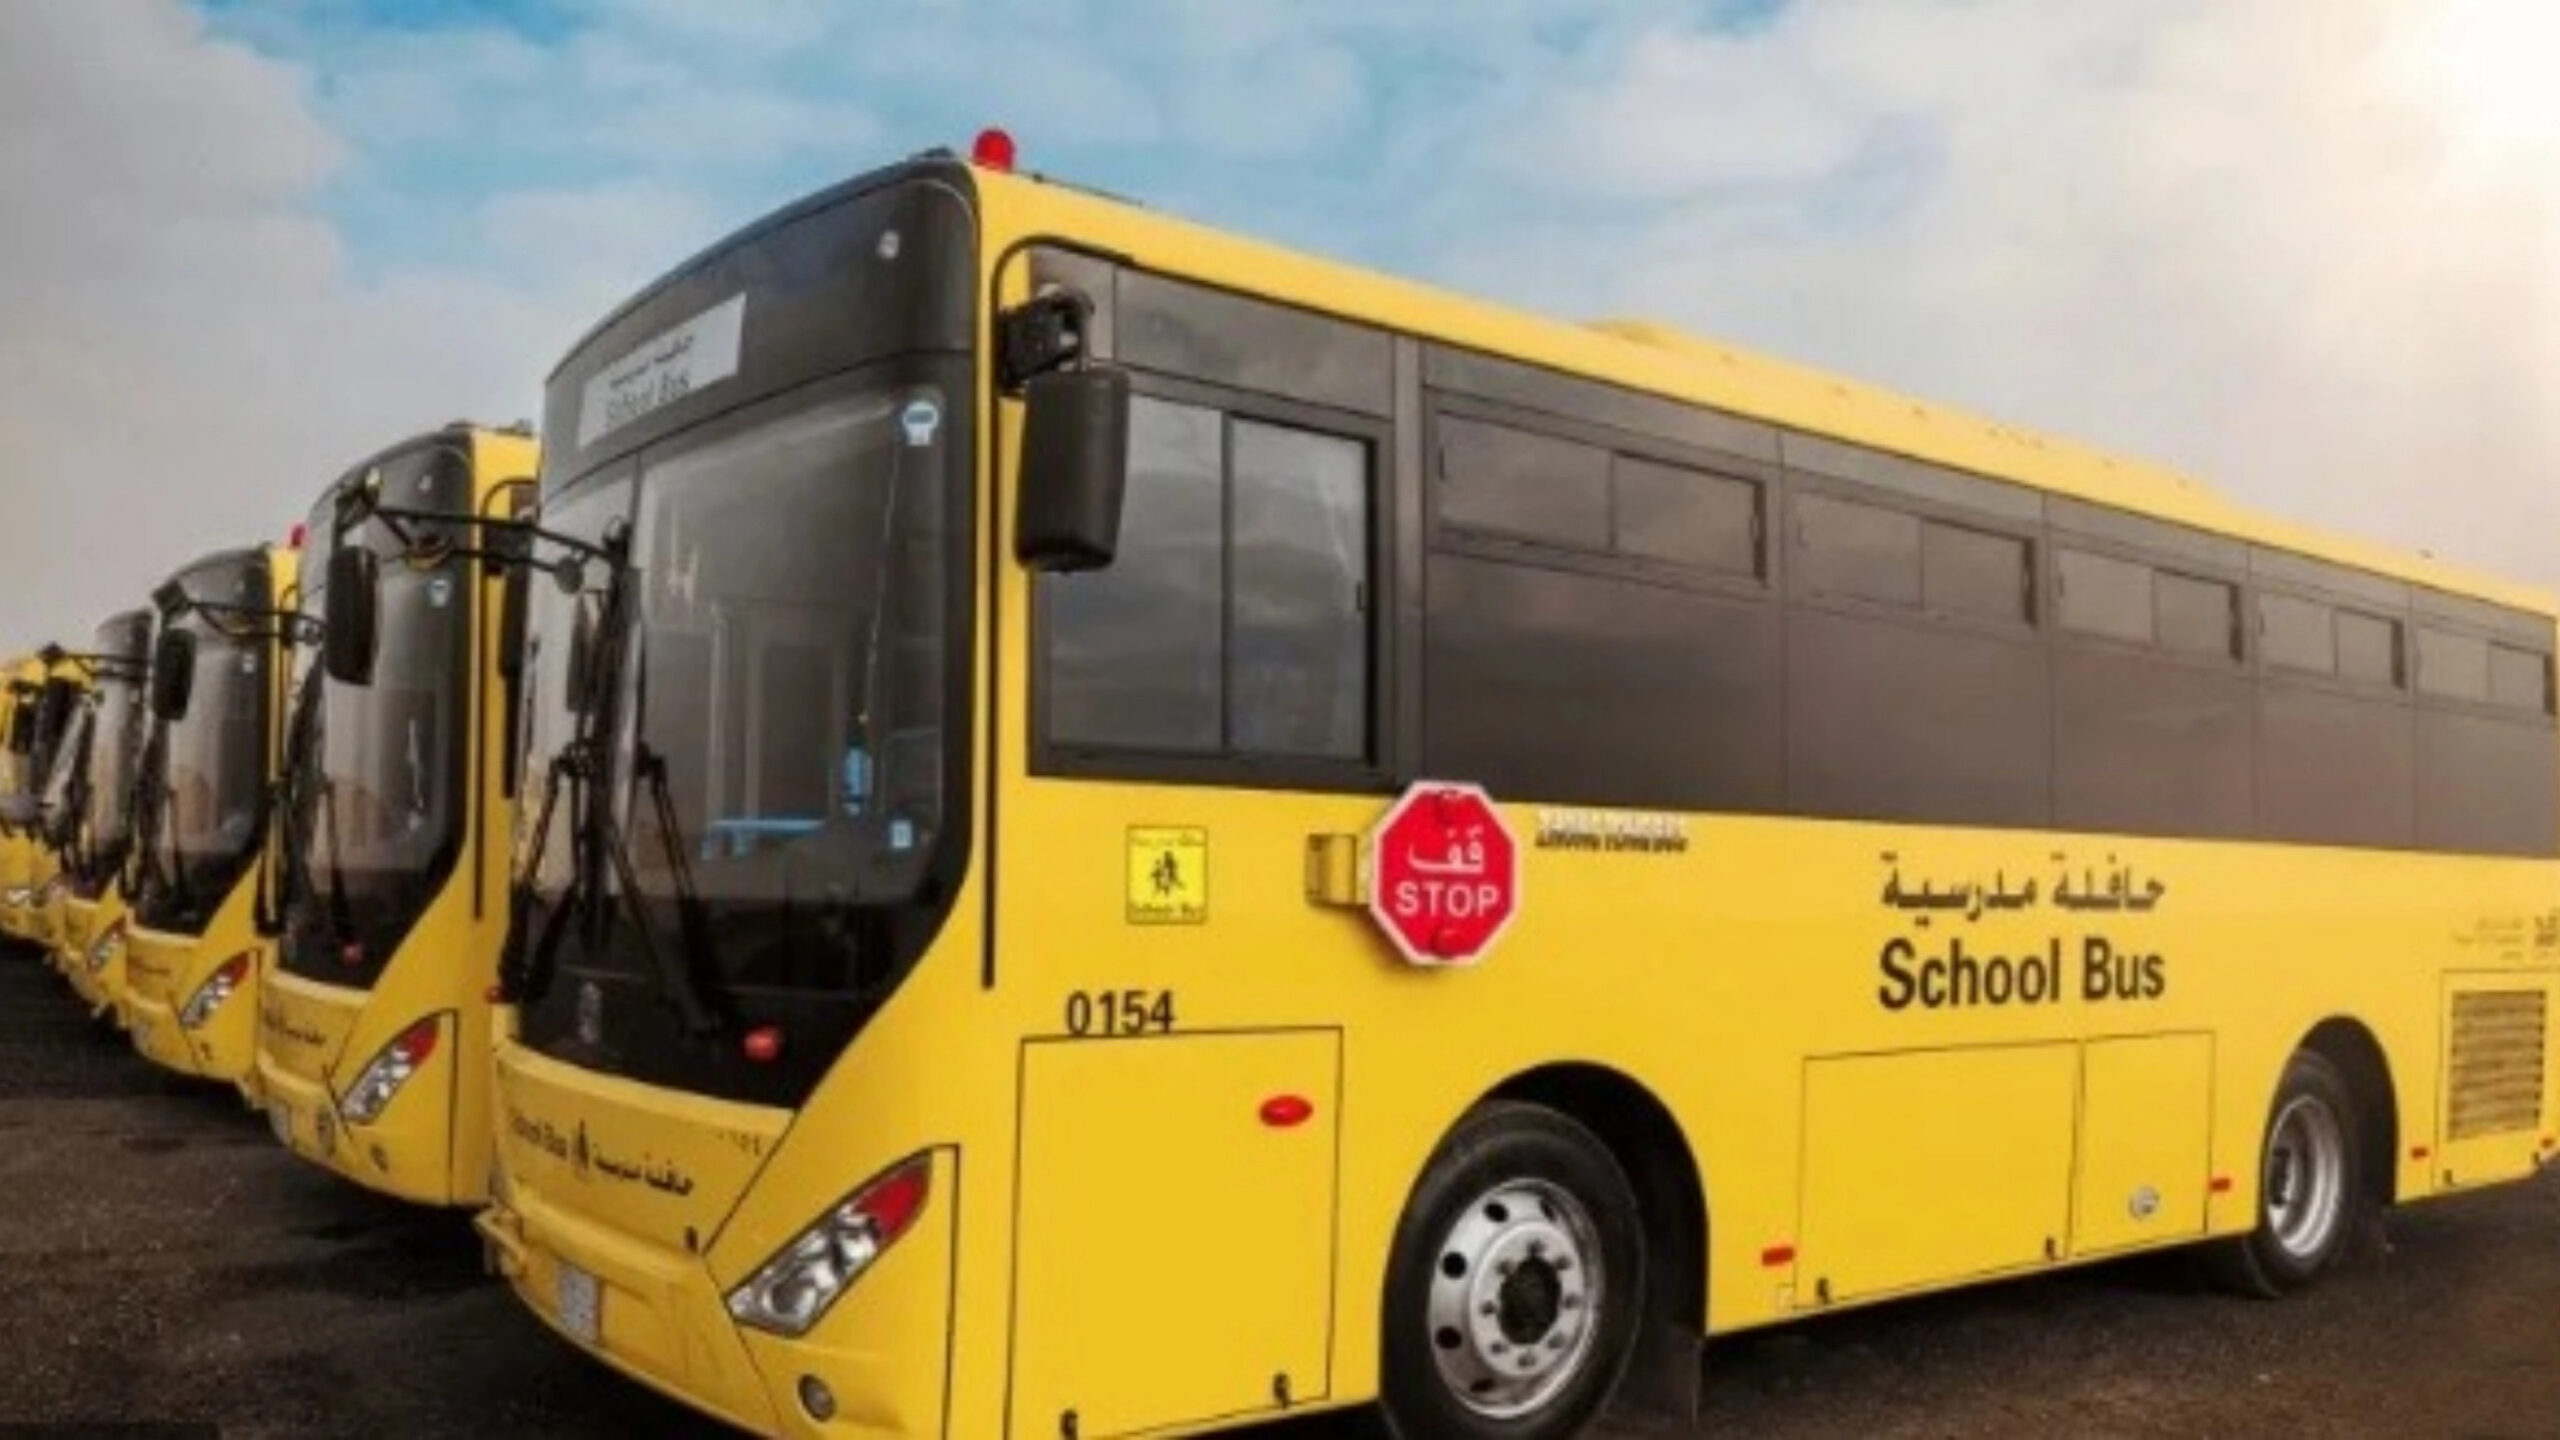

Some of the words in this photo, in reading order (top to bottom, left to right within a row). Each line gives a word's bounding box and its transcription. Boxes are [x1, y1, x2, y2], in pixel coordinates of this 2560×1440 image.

[1395, 881, 1499, 918] STOP
[1879, 850, 2037, 926] مدرسية
[2052, 851, 2165, 910] حافلة
[1878, 936, 2061, 1012] School
[2083, 936, 2166, 1001] Bus
[1066, 989, 1175, 1036] 0154
